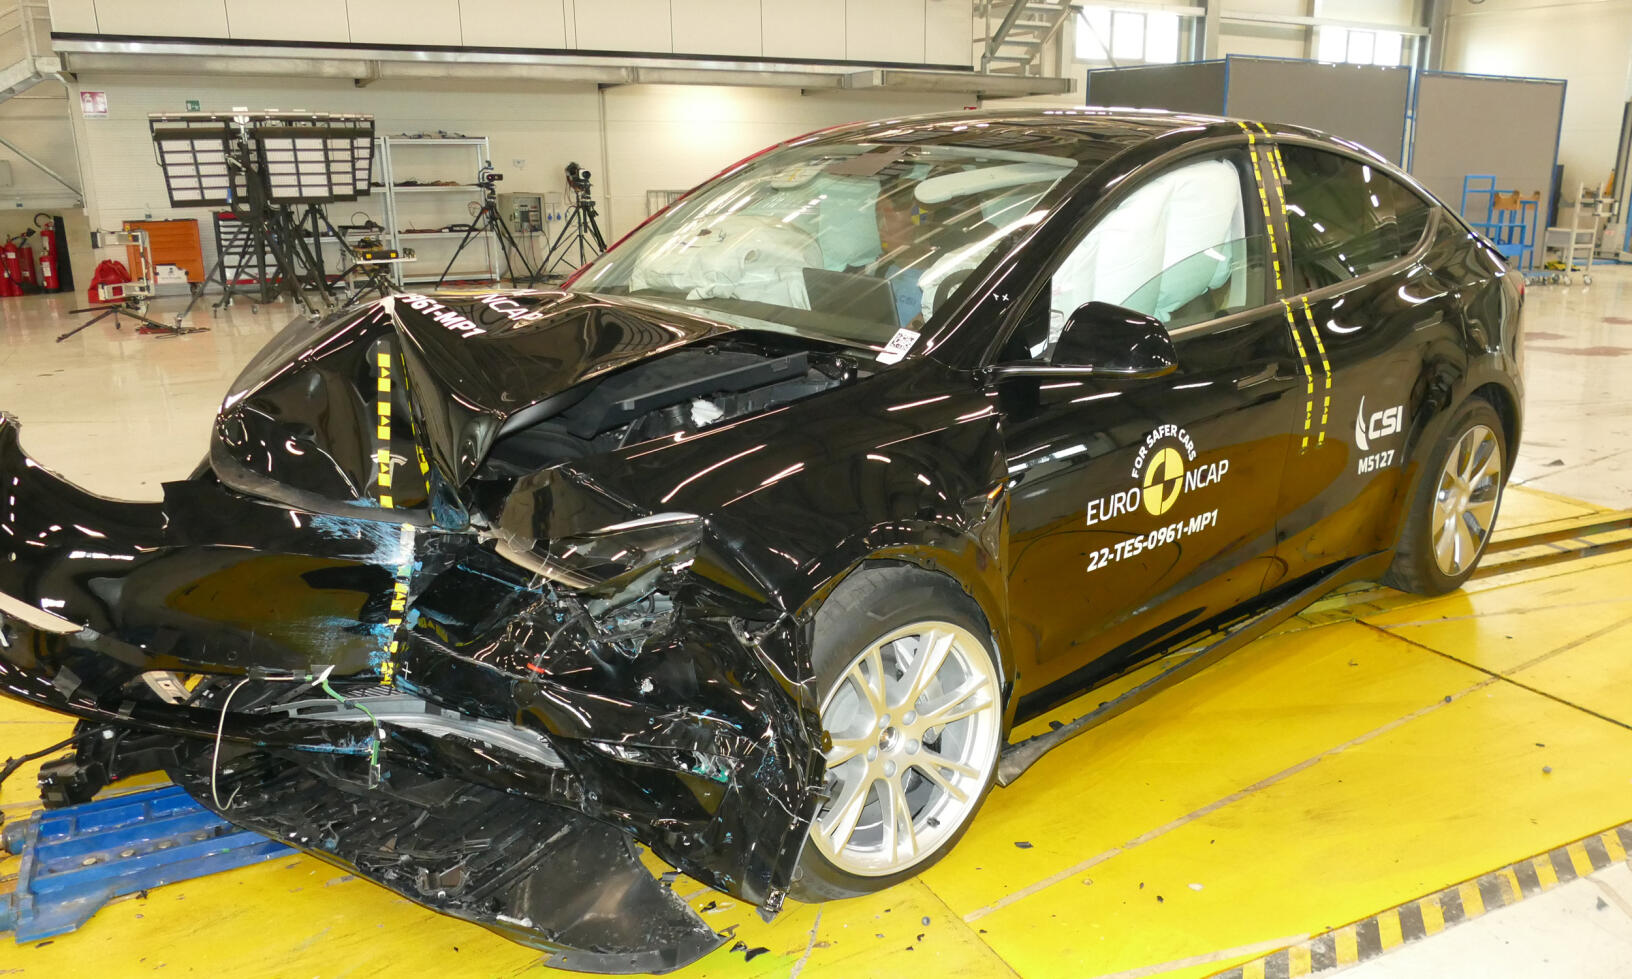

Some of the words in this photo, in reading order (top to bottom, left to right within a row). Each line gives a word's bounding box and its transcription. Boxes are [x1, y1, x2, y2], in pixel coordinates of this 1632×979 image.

[394, 293, 487, 338] 961-MP1
[474, 293, 543, 321] NCAP
[1368, 405, 1403, 440] CSI
[1131, 446, 1148, 479] FOR
[1146, 424, 1178, 449] SAFER
[1178, 429, 1197, 462] CARS
[1358, 449, 1395, 475] M5127
[1086, 487, 1141, 526] EURO
[1184, 459, 1229, 493] NCAP
[1086, 509, 1218, 573] 22-TES-0961-MP1
